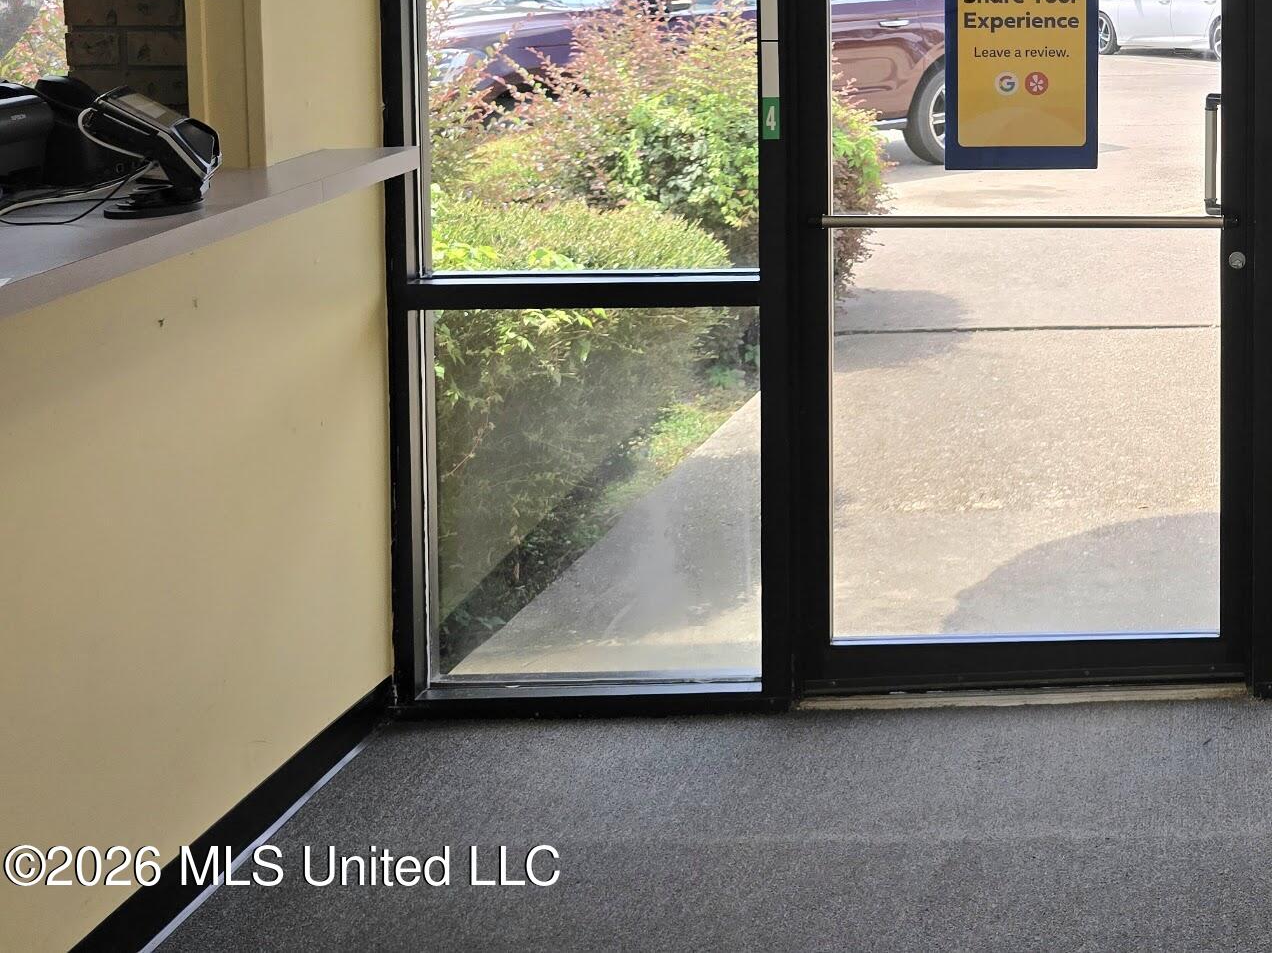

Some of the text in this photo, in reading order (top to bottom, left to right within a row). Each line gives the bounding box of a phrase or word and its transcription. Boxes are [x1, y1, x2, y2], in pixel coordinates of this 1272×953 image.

[963, 11, 1080, 34] Experience
[974, 46, 1070, 58] Leave a review.
[765, 105, 777, 131] 4
